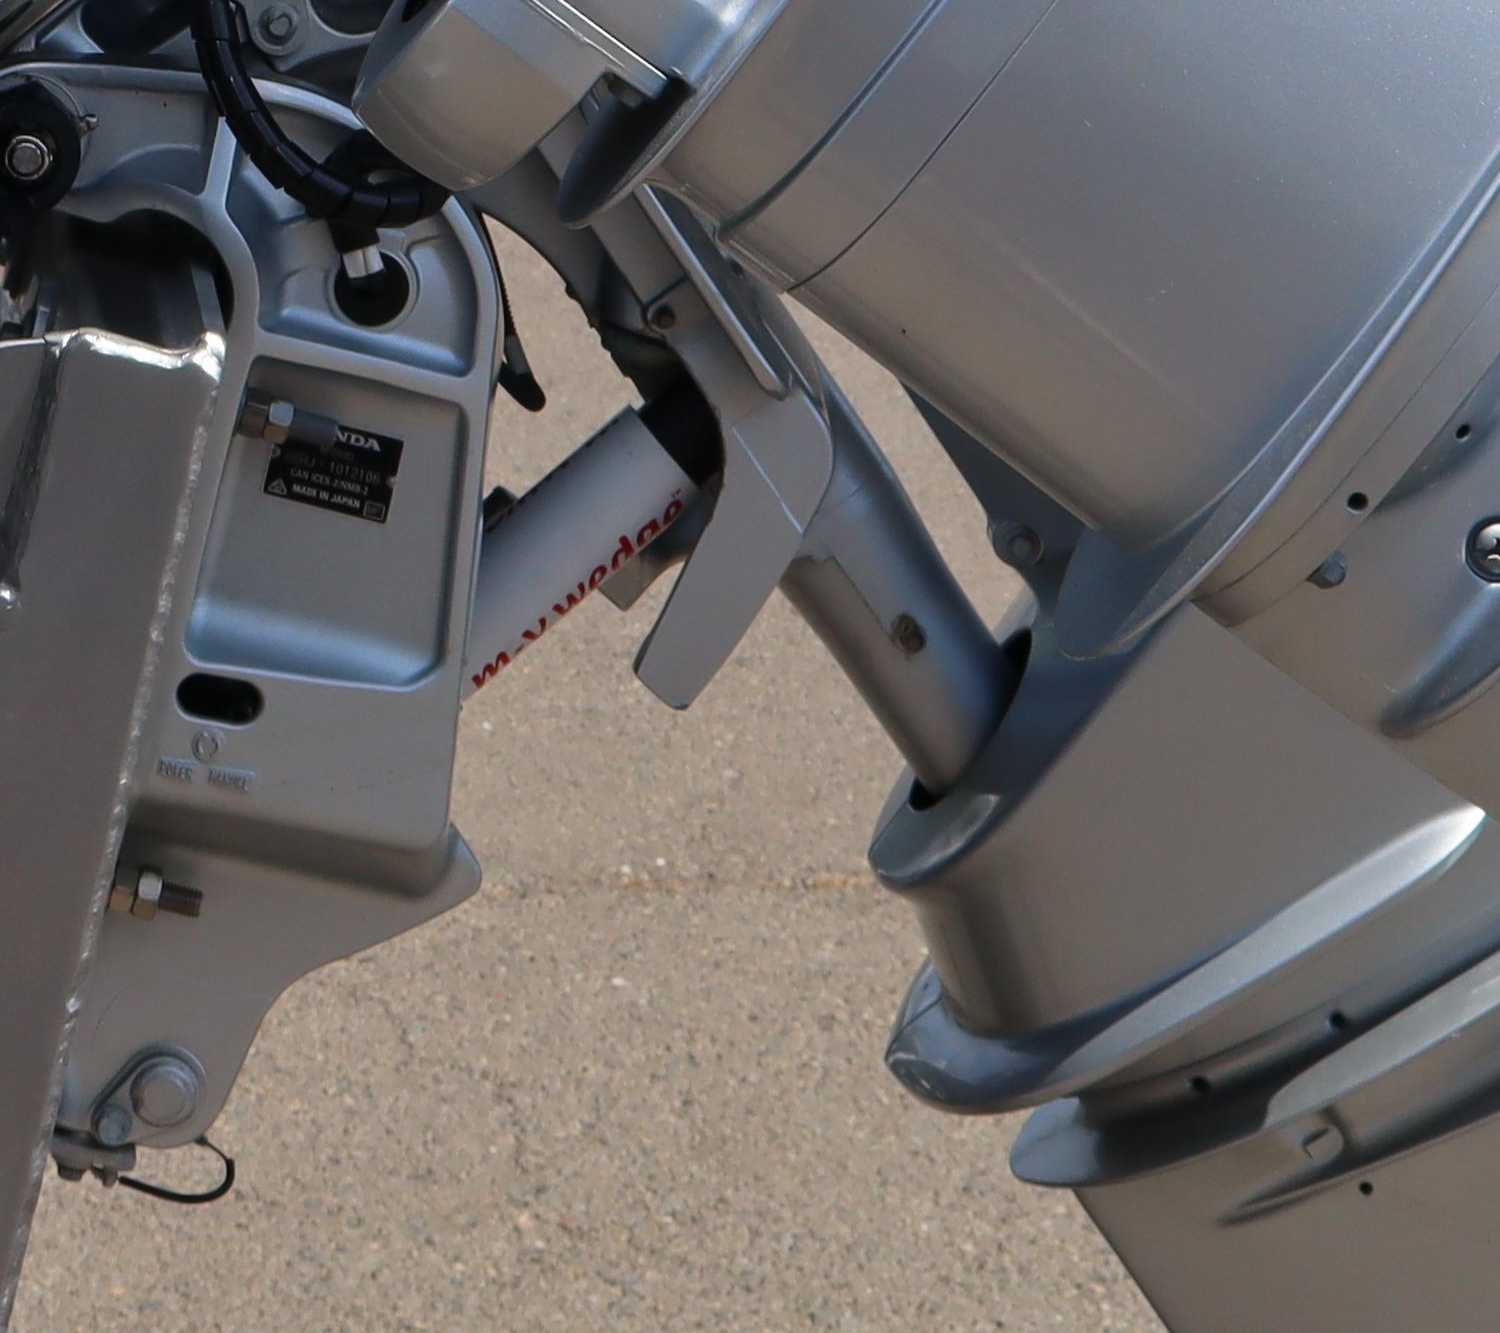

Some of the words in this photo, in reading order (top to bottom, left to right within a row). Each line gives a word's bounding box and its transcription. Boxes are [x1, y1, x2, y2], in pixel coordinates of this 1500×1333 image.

[292, 483, 318, 498] MADE
[319, 489, 330, 502] IN
[330, 491, 361, 509] JAPAN
